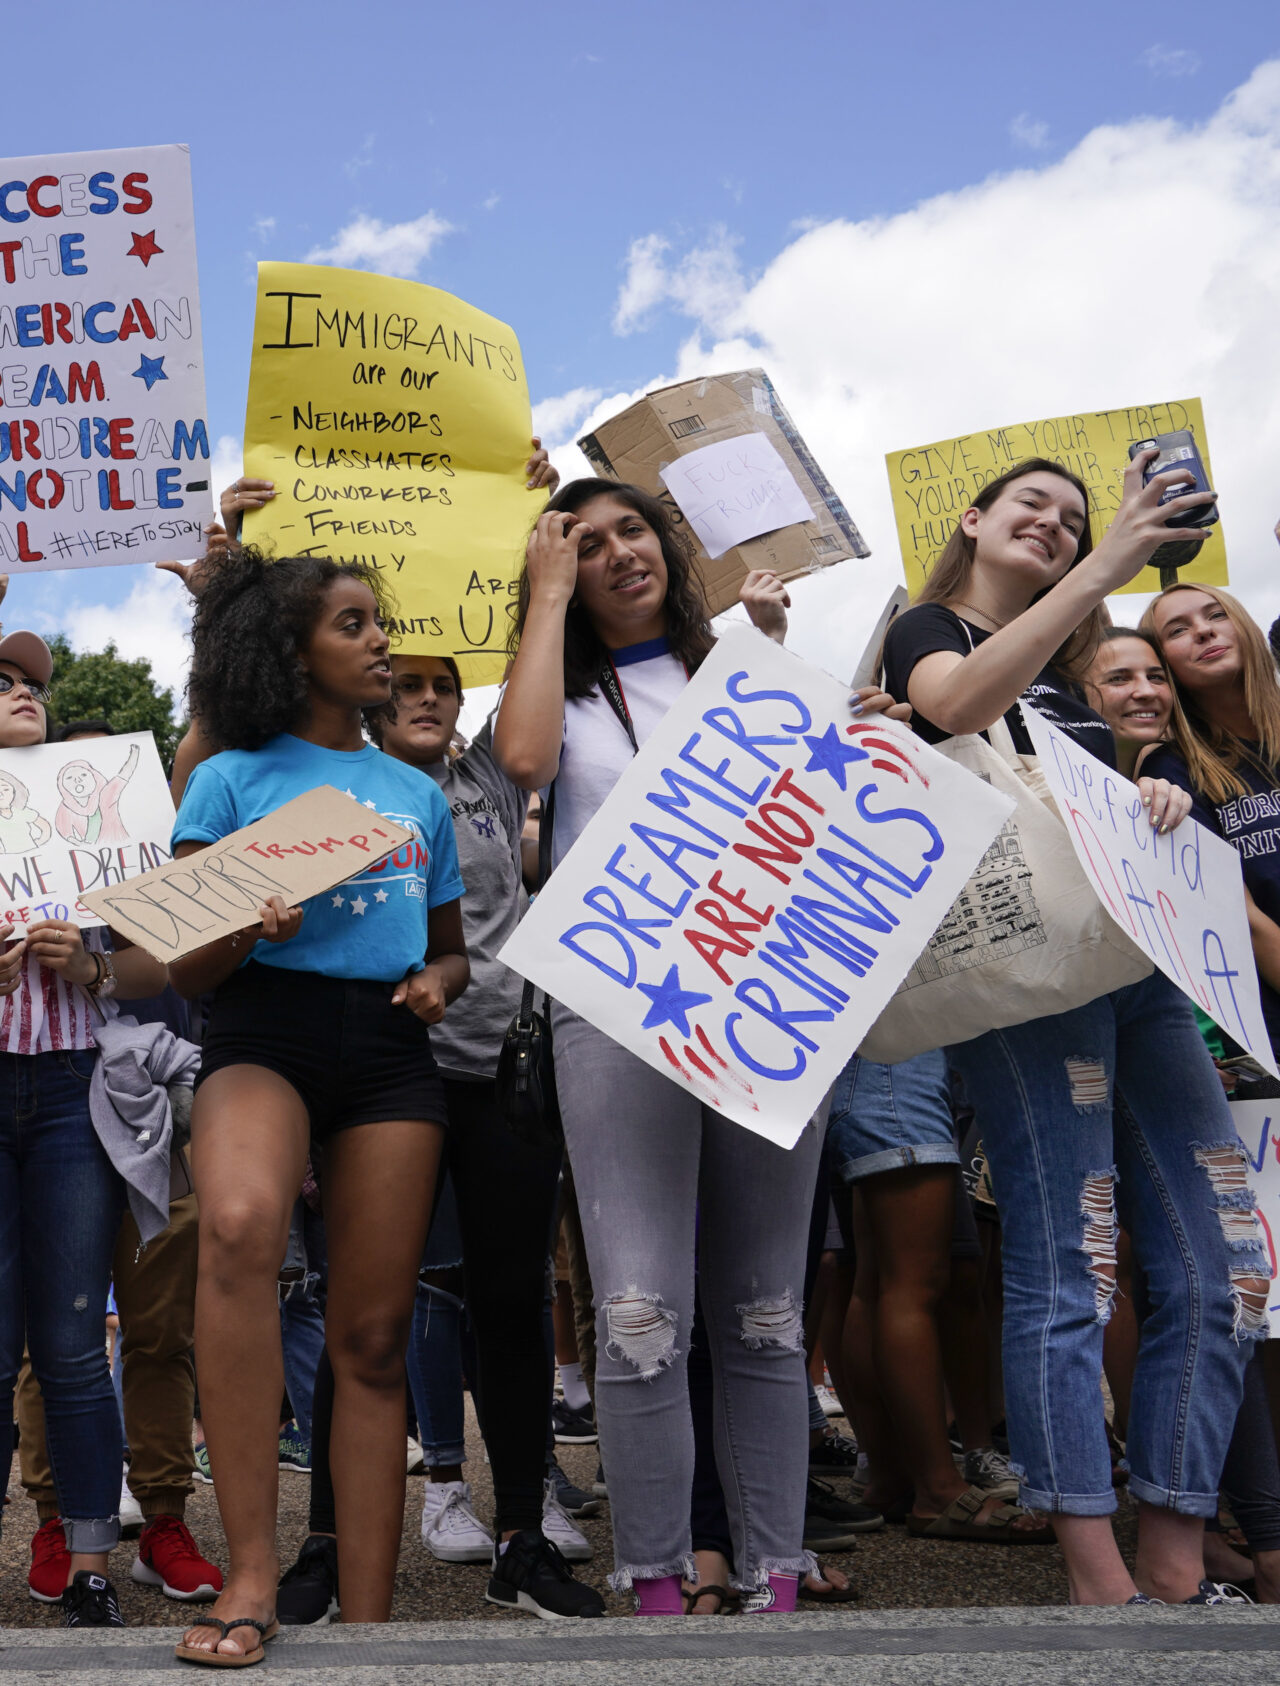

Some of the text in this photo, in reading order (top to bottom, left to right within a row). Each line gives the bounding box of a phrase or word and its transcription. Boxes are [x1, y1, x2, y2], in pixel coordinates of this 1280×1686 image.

[262, 291, 517, 382] IMMIGRANTS
[353, 362, 439, 390] are our
[42, 416, 210, 461] DREAM
[293, 401, 443, 437] NEIGHBORS
[295, 445, 455, 477] CLASSMATES
[900, 436, 980, 484] GIVE
[987, 427, 1024, 465] ME
[1023, 415, 1090, 456] YOUR
[293, 478, 452, 505] COWORKERS
[684, 453, 768, 494] FUCK
[690, 479, 782, 533] TRUMP
[905, 477, 972, 519] YOUR
[305, 509, 417, 537] FRIENDS
[466, 570, 521, 597] ARE
[558, 670, 812, 989] DREAMERS
[103, 845, 294, 949] DEPORT
[244, 827, 397, 861] TRUMP!
[683, 767, 826, 986] ARE NOT
[34, 901, 68, 921] TO
[725, 783, 945, 1082] CRIMINALS
[1065, 798, 1254, 1053] DACA
